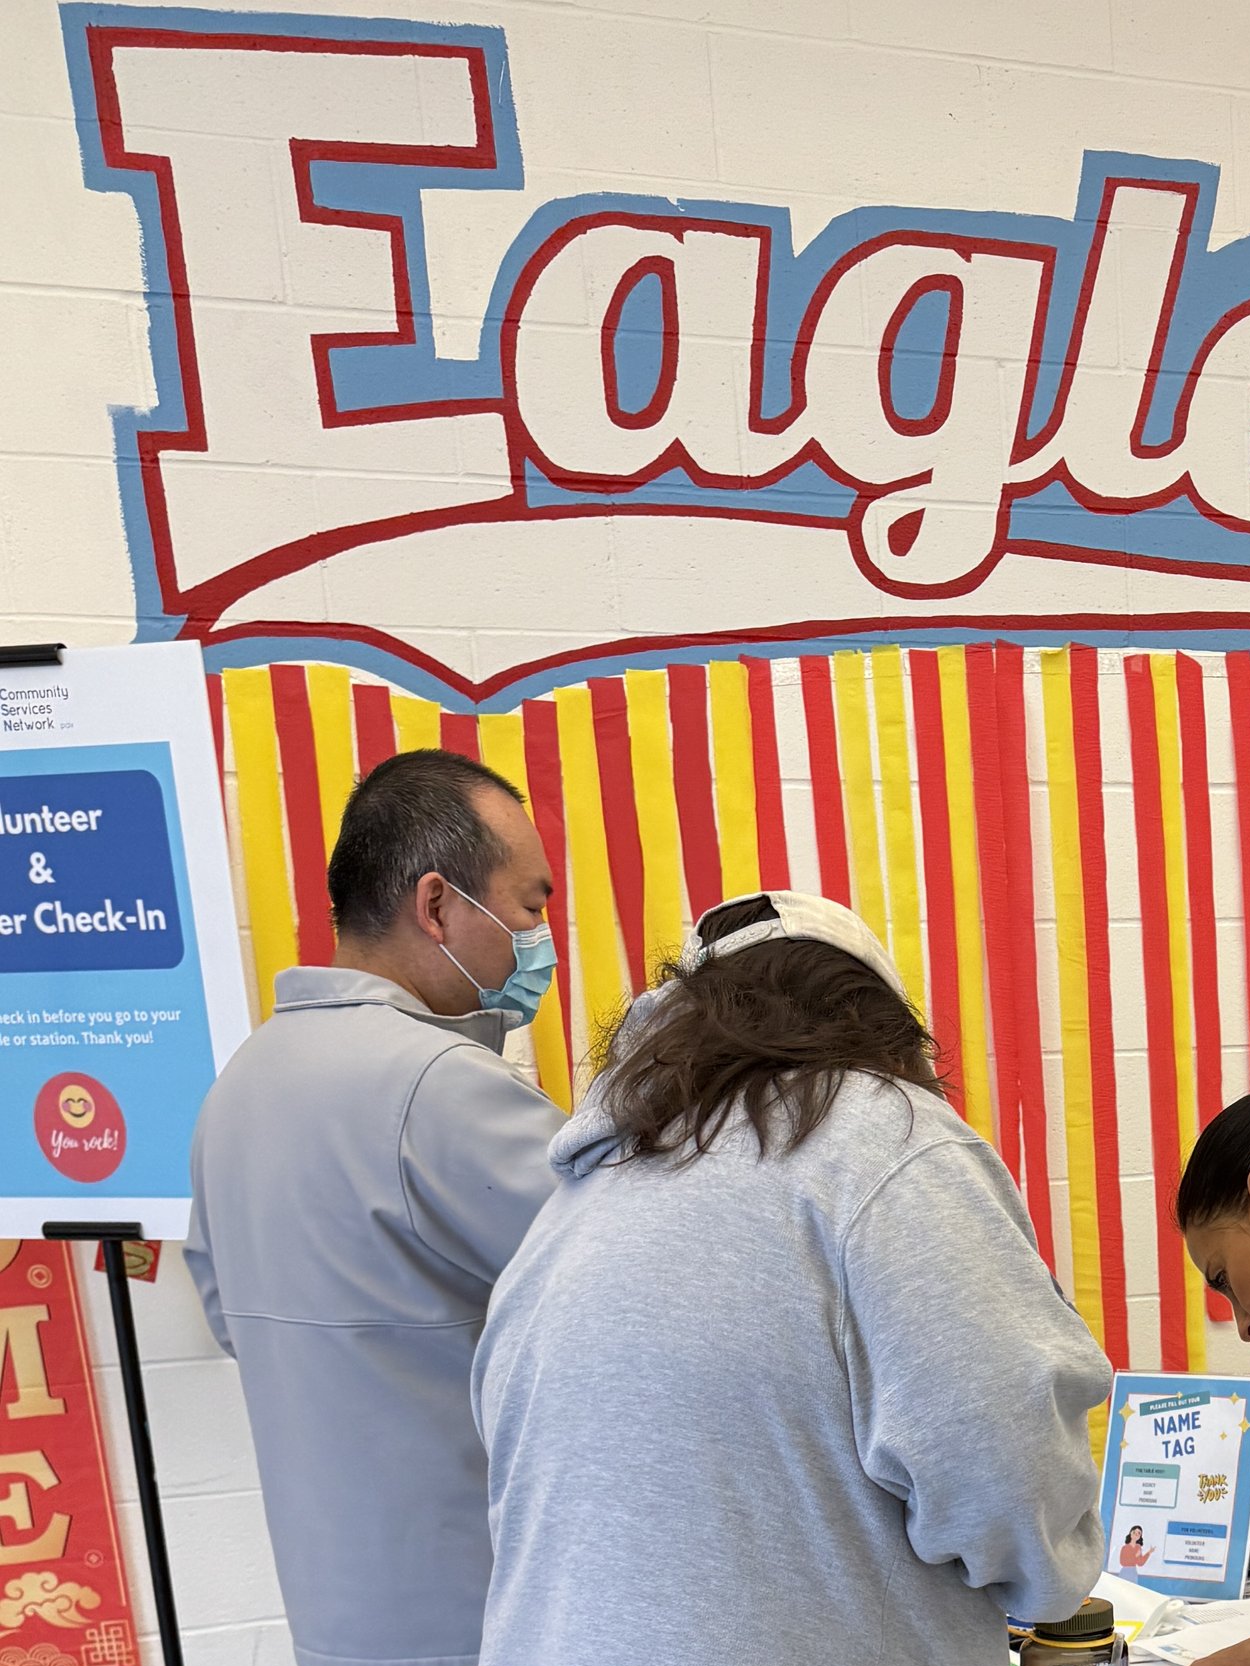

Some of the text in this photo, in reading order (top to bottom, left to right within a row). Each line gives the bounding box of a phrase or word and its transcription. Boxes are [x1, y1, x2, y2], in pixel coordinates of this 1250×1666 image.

[0, 684, 69, 701] Community
[1, 701, 53, 716] Services
[4, 717, 55, 732] Network
[28, 851, 56, 884] &
[34, 899, 167, 944] Check-In
[27, 1010, 40, 1024] in
[42, 1009, 86, 1024] before
[87, 1013, 113, 1027] you
[115, 1013, 127, 1026] go
[134, 1010, 148, 1022] to
[152, 1010, 181, 1025] your
[13, 1037, 27, 1046] or
[30, 1033, 80, 1046] station.
[81, 1031, 123, 1045] Thank
[126, 1031, 155, 1048] you!
[51, 1128, 119, 1158] You rock!
[1153, 1411, 1201, 1436] NAME
[1162, 1436, 1195, 1458] TAG
[1198, 1473, 1228, 1490] THANK
[1203, 1487, 1222, 1504] YOU
